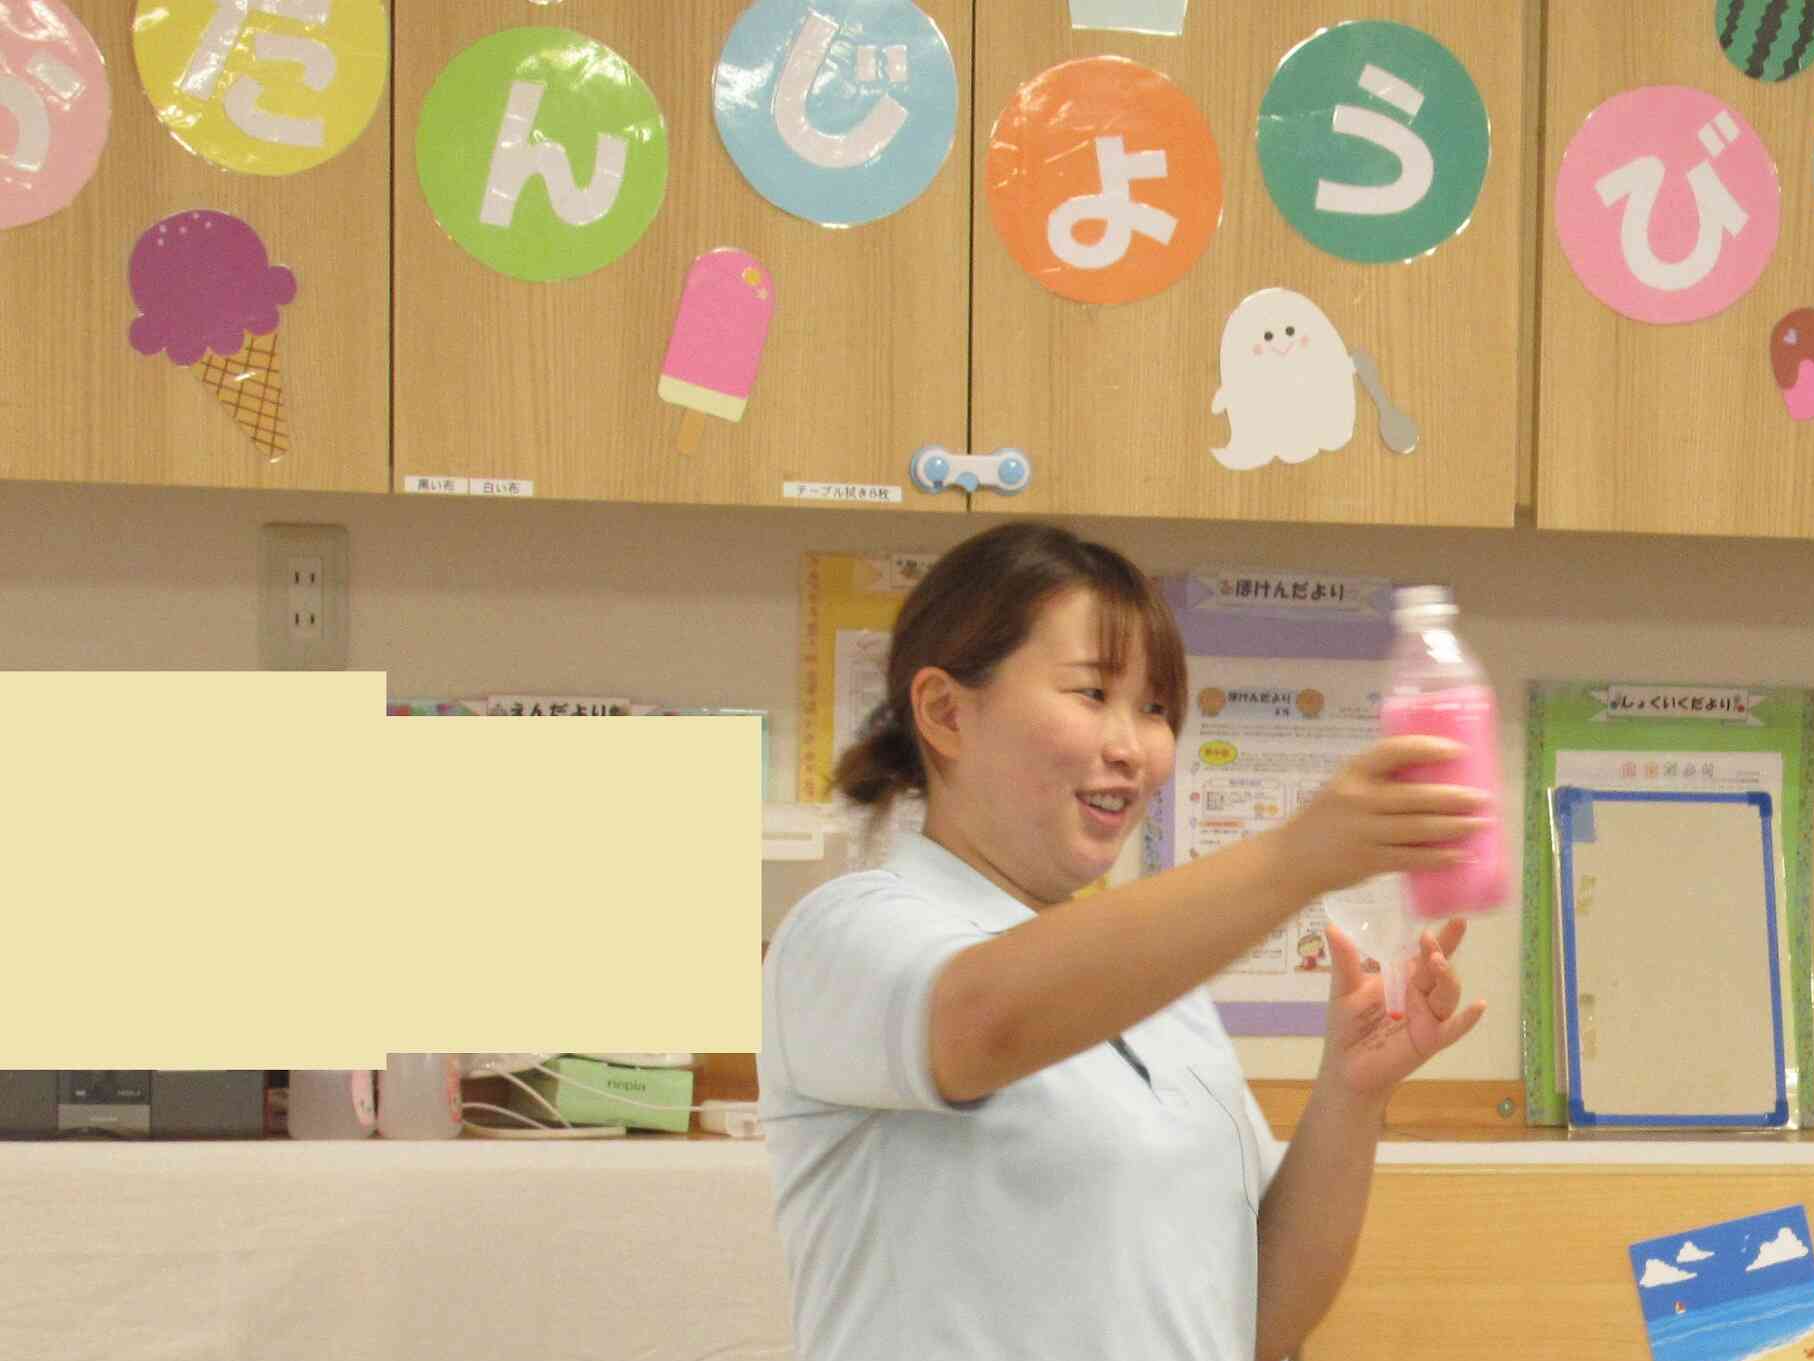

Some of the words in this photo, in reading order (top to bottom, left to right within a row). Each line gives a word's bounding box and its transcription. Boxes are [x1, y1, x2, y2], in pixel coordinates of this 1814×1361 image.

[1235, 580, 1344, 600] ほけんだより
[1228, 691, 1290, 704] ほけんだより
[1621, 696, 1731, 712] しょくいくだより
[607, 1080, 646, 1092] nepia
